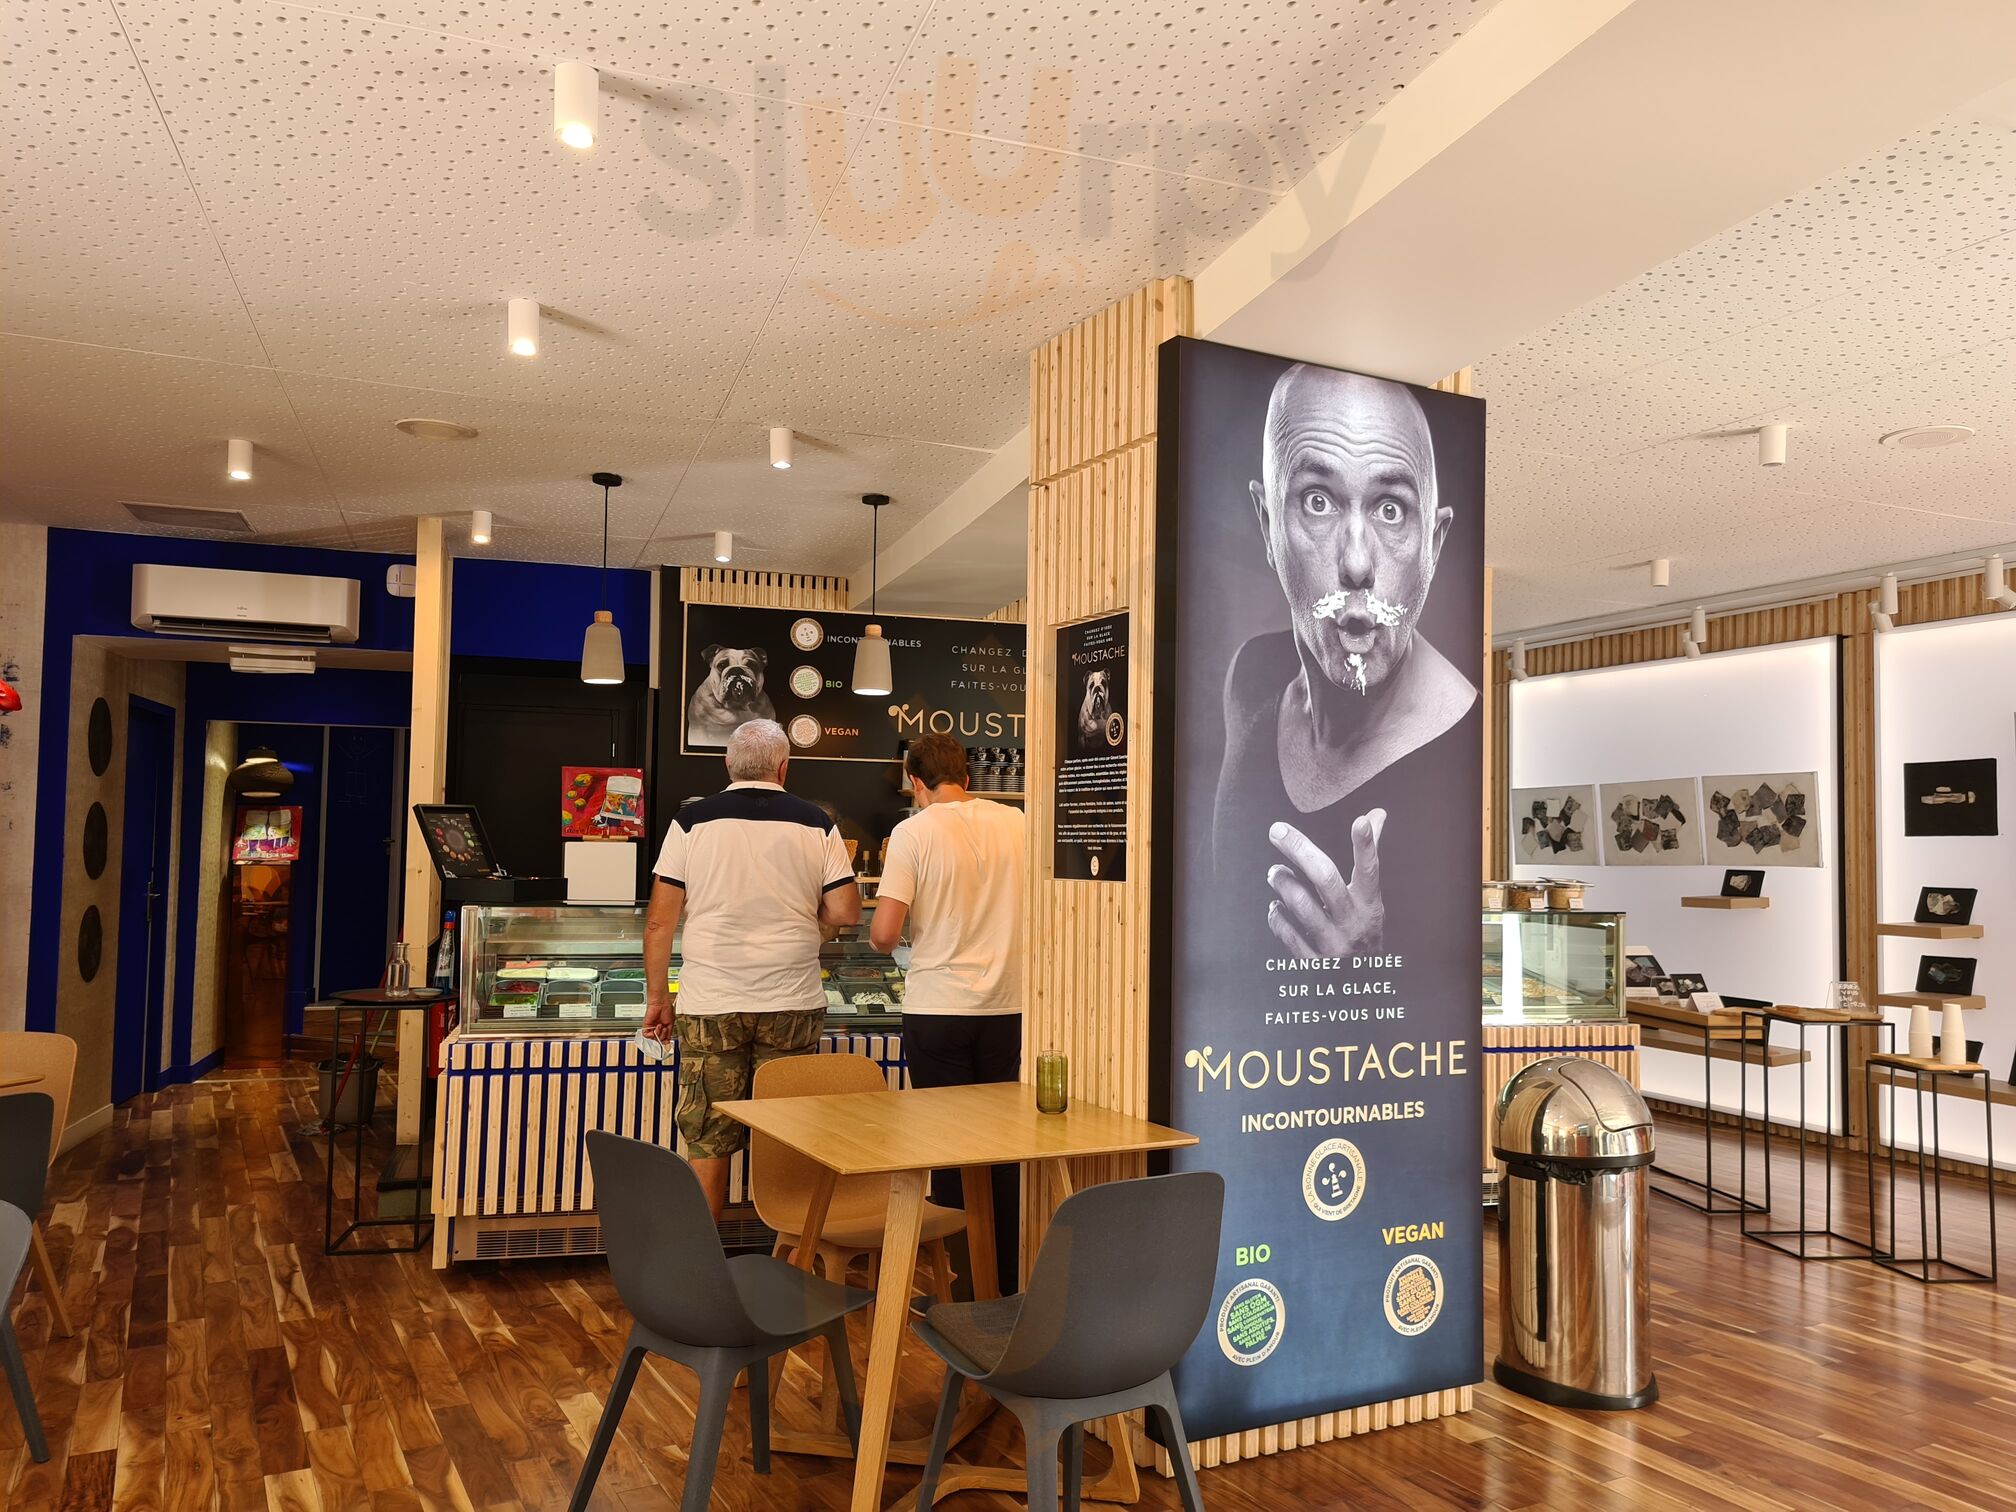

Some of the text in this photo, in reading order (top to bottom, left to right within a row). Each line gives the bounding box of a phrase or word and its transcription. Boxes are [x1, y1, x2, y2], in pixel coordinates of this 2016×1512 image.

[827, 635, 922, 648] INCONNABLES
[951, 645, 1012, 657] CHANGEZ
[1071, 645, 1126, 666] MOUSTACHE
[962, 663, 1027, 675] SUR LA GL
[825, 680, 843, 689] BIO
[951, 680, 1027, 692] FAITES-VOU
[888, 703, 1027, 738] MOUST
[824, 727, 859, 737] VEGAN
[1265, 953, 1404, 972] CHANGEZ D'IDÉE
[1278, 981, 1397, 998] SUR LA GLACE,
[1265, 1007, 1405, 1025] FAITES-VOUS UNE
[1184, 1040, 1468, 1093] MOUSTACHE
[1241, 1101, 1425, 1133] INCONTOURNABLES
[1382, 1221, 1445, 1246] VEGAN
[1235, 1244, 1271, 1267] BIO
